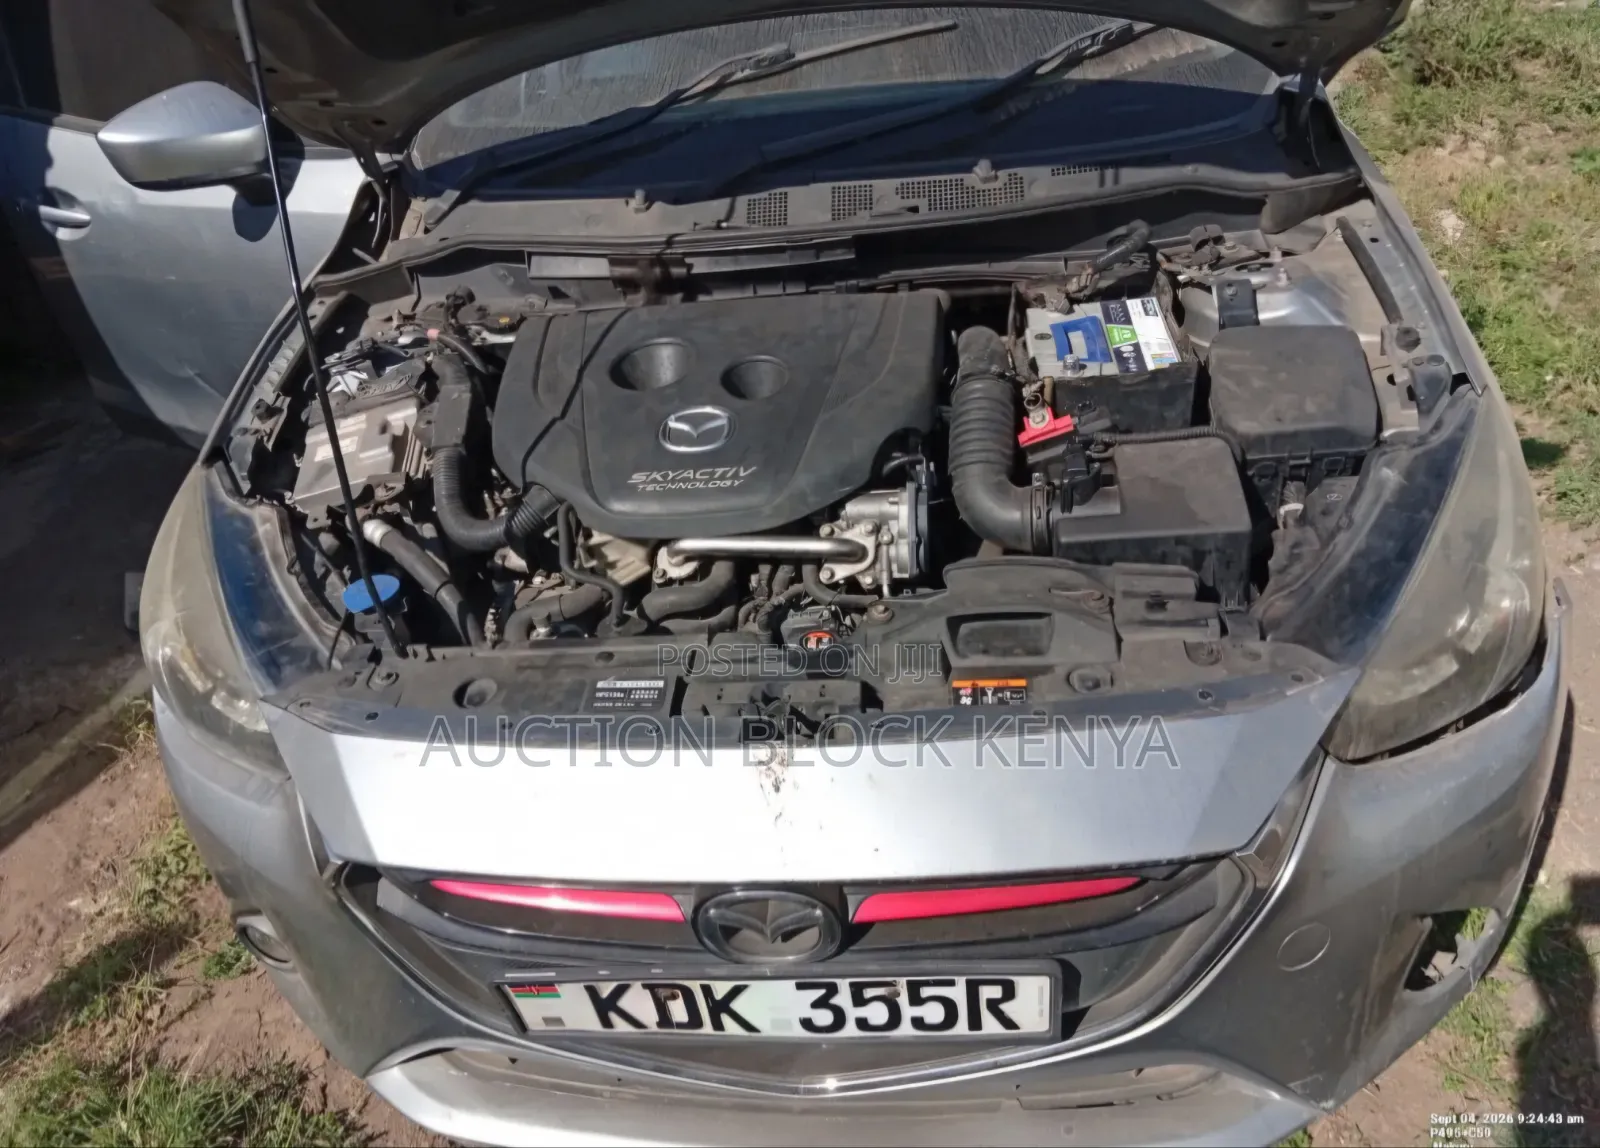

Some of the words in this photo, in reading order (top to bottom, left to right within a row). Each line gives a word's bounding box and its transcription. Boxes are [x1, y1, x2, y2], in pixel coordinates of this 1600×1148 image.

[627, 466, 757, 484] SKYACTIV
[638, 479, 744, 492] TECHNOLOGY
[583, 983, 761, 1034] KDK
[795, 978, 1020, 1032] 355R
